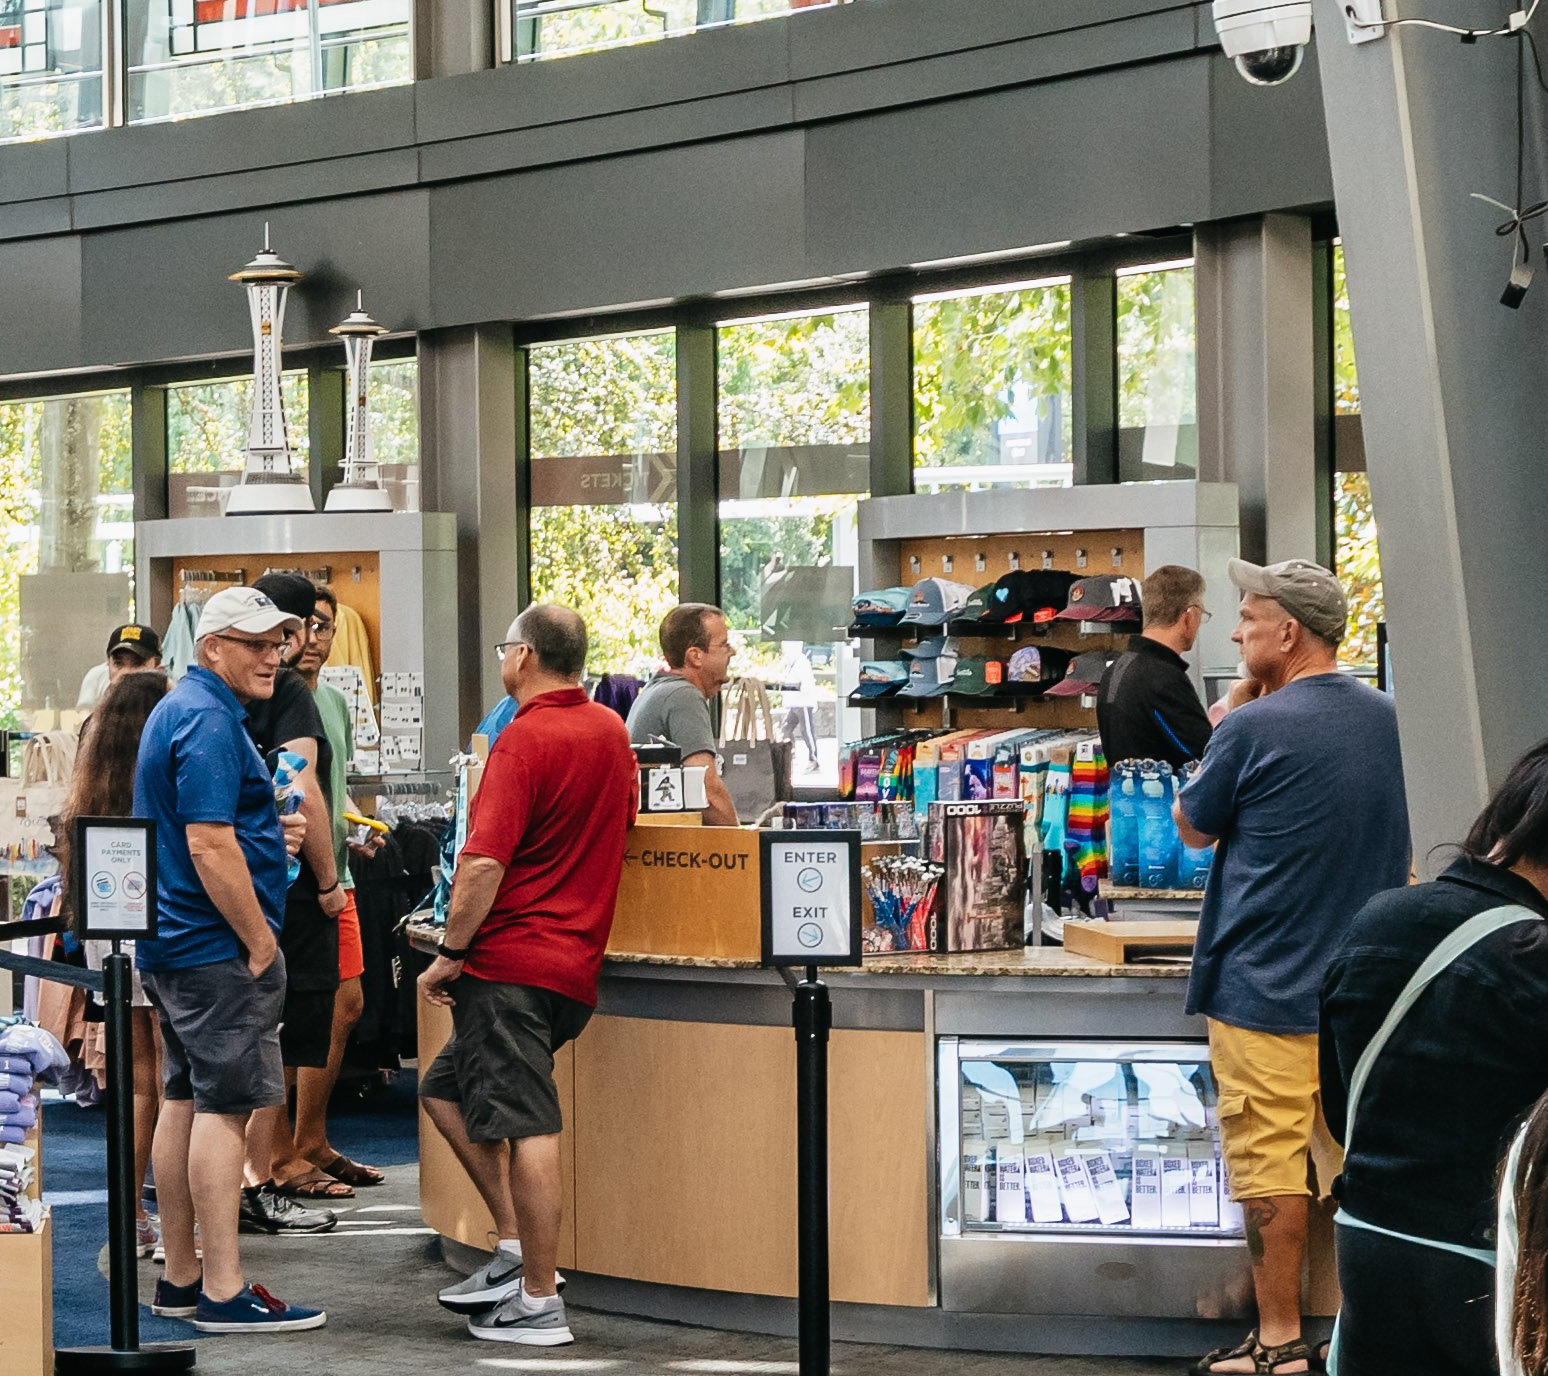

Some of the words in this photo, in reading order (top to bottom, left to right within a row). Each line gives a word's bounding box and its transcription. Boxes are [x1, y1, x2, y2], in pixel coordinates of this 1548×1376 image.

[946, 804, 982, 816] 1000
[110, 841, 132, 849] CARD
[101, 849, 141, 857] PAYMENTS
[784, 851, 837, 864] ENTER
[641, 850, 749, 871] CHECK-OUT
[792, 906, 829, 919] EXIT
